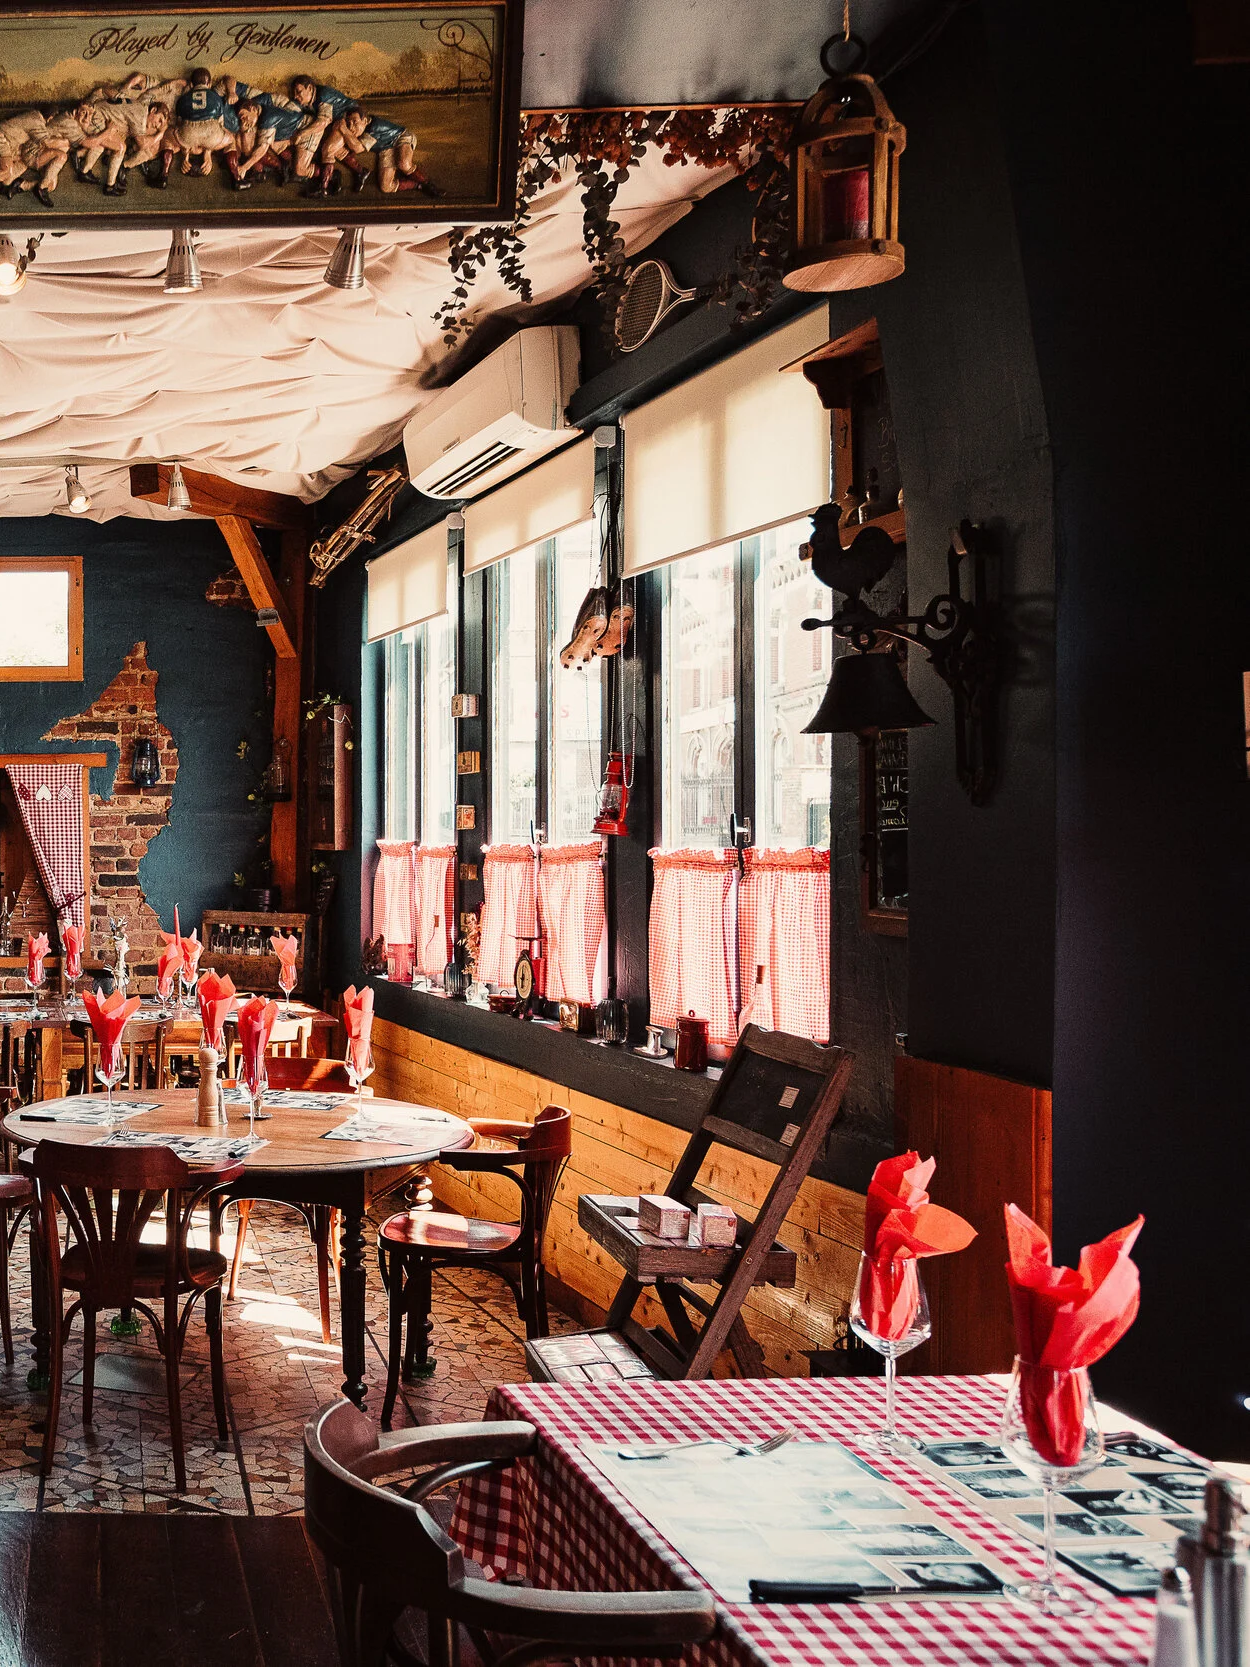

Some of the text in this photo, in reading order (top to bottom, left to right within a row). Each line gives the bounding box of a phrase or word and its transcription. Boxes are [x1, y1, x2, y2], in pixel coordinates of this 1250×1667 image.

[83, 21, 340, 65] Played by Gentlemen
[192, 90, 207, 110] 9
